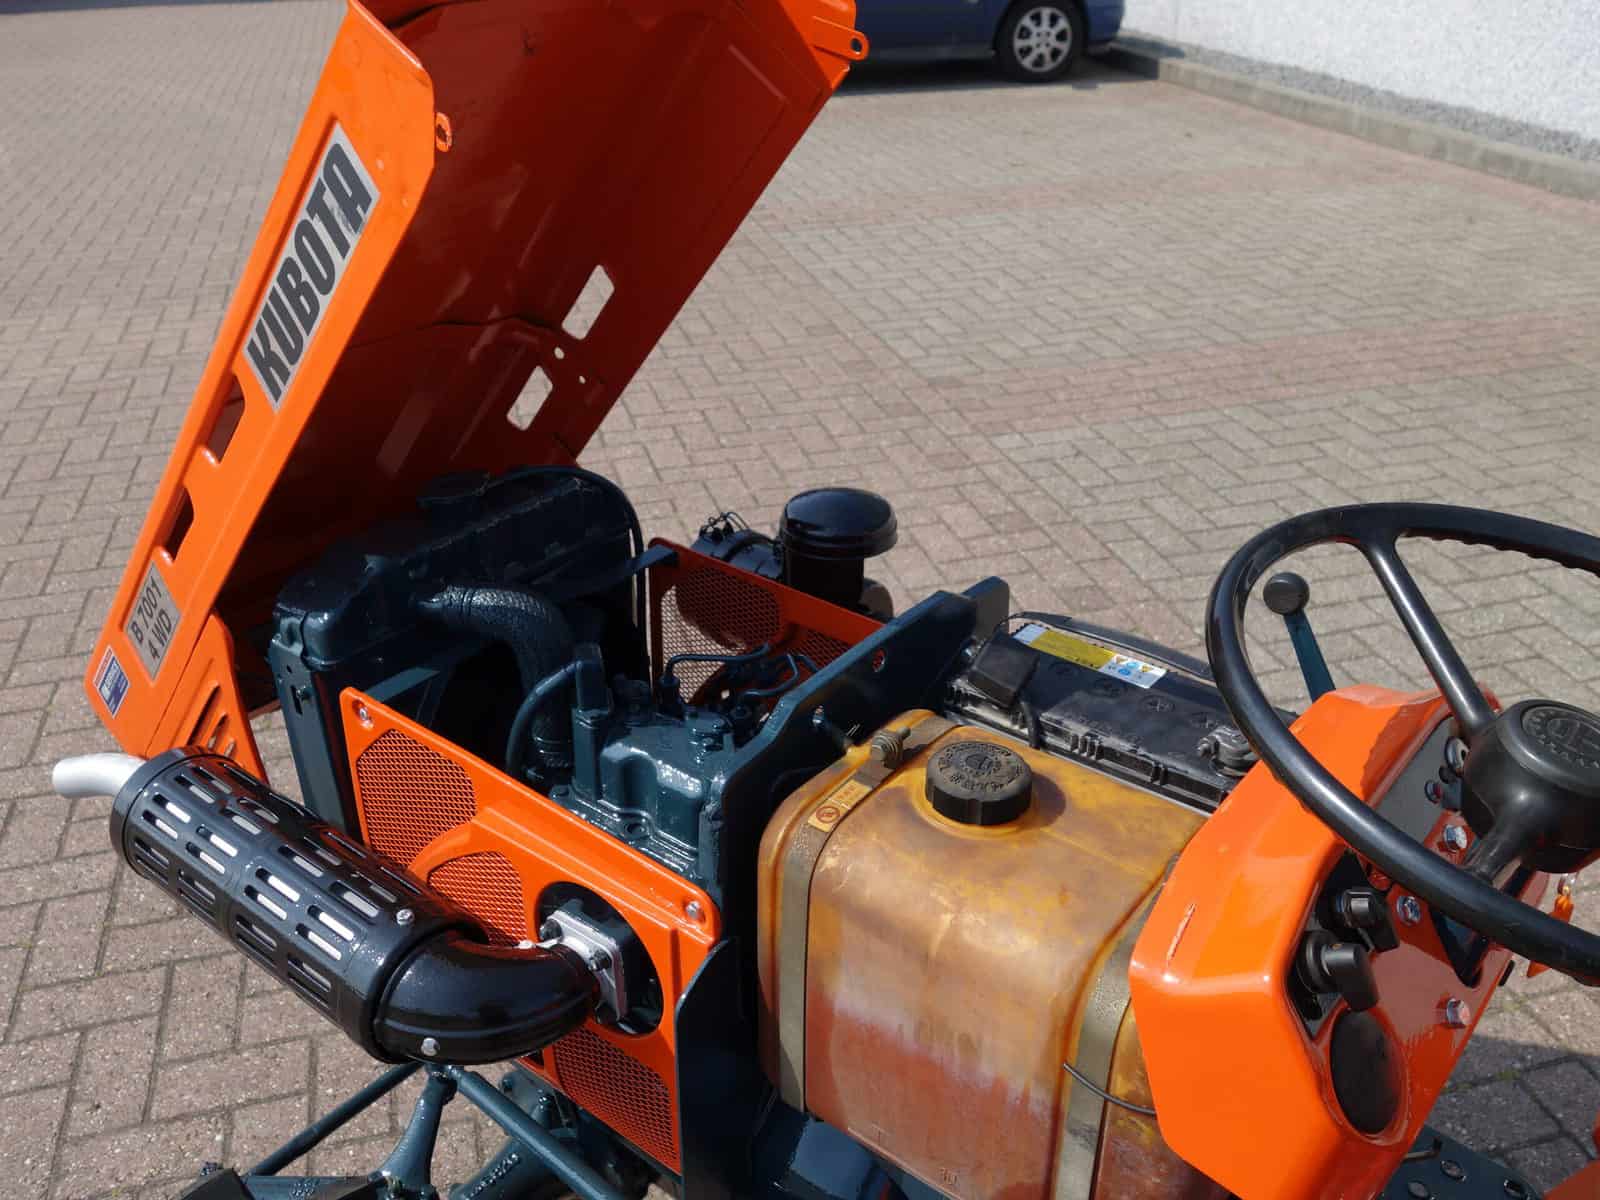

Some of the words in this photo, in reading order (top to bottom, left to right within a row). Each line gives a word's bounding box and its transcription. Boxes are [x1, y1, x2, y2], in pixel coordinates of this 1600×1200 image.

[246, 143, 373, 403] KUBOTA
[130, 620, 144, 644] B
[137, 575, 163, 628] 7001
[152, 609, 172, 648] WD
